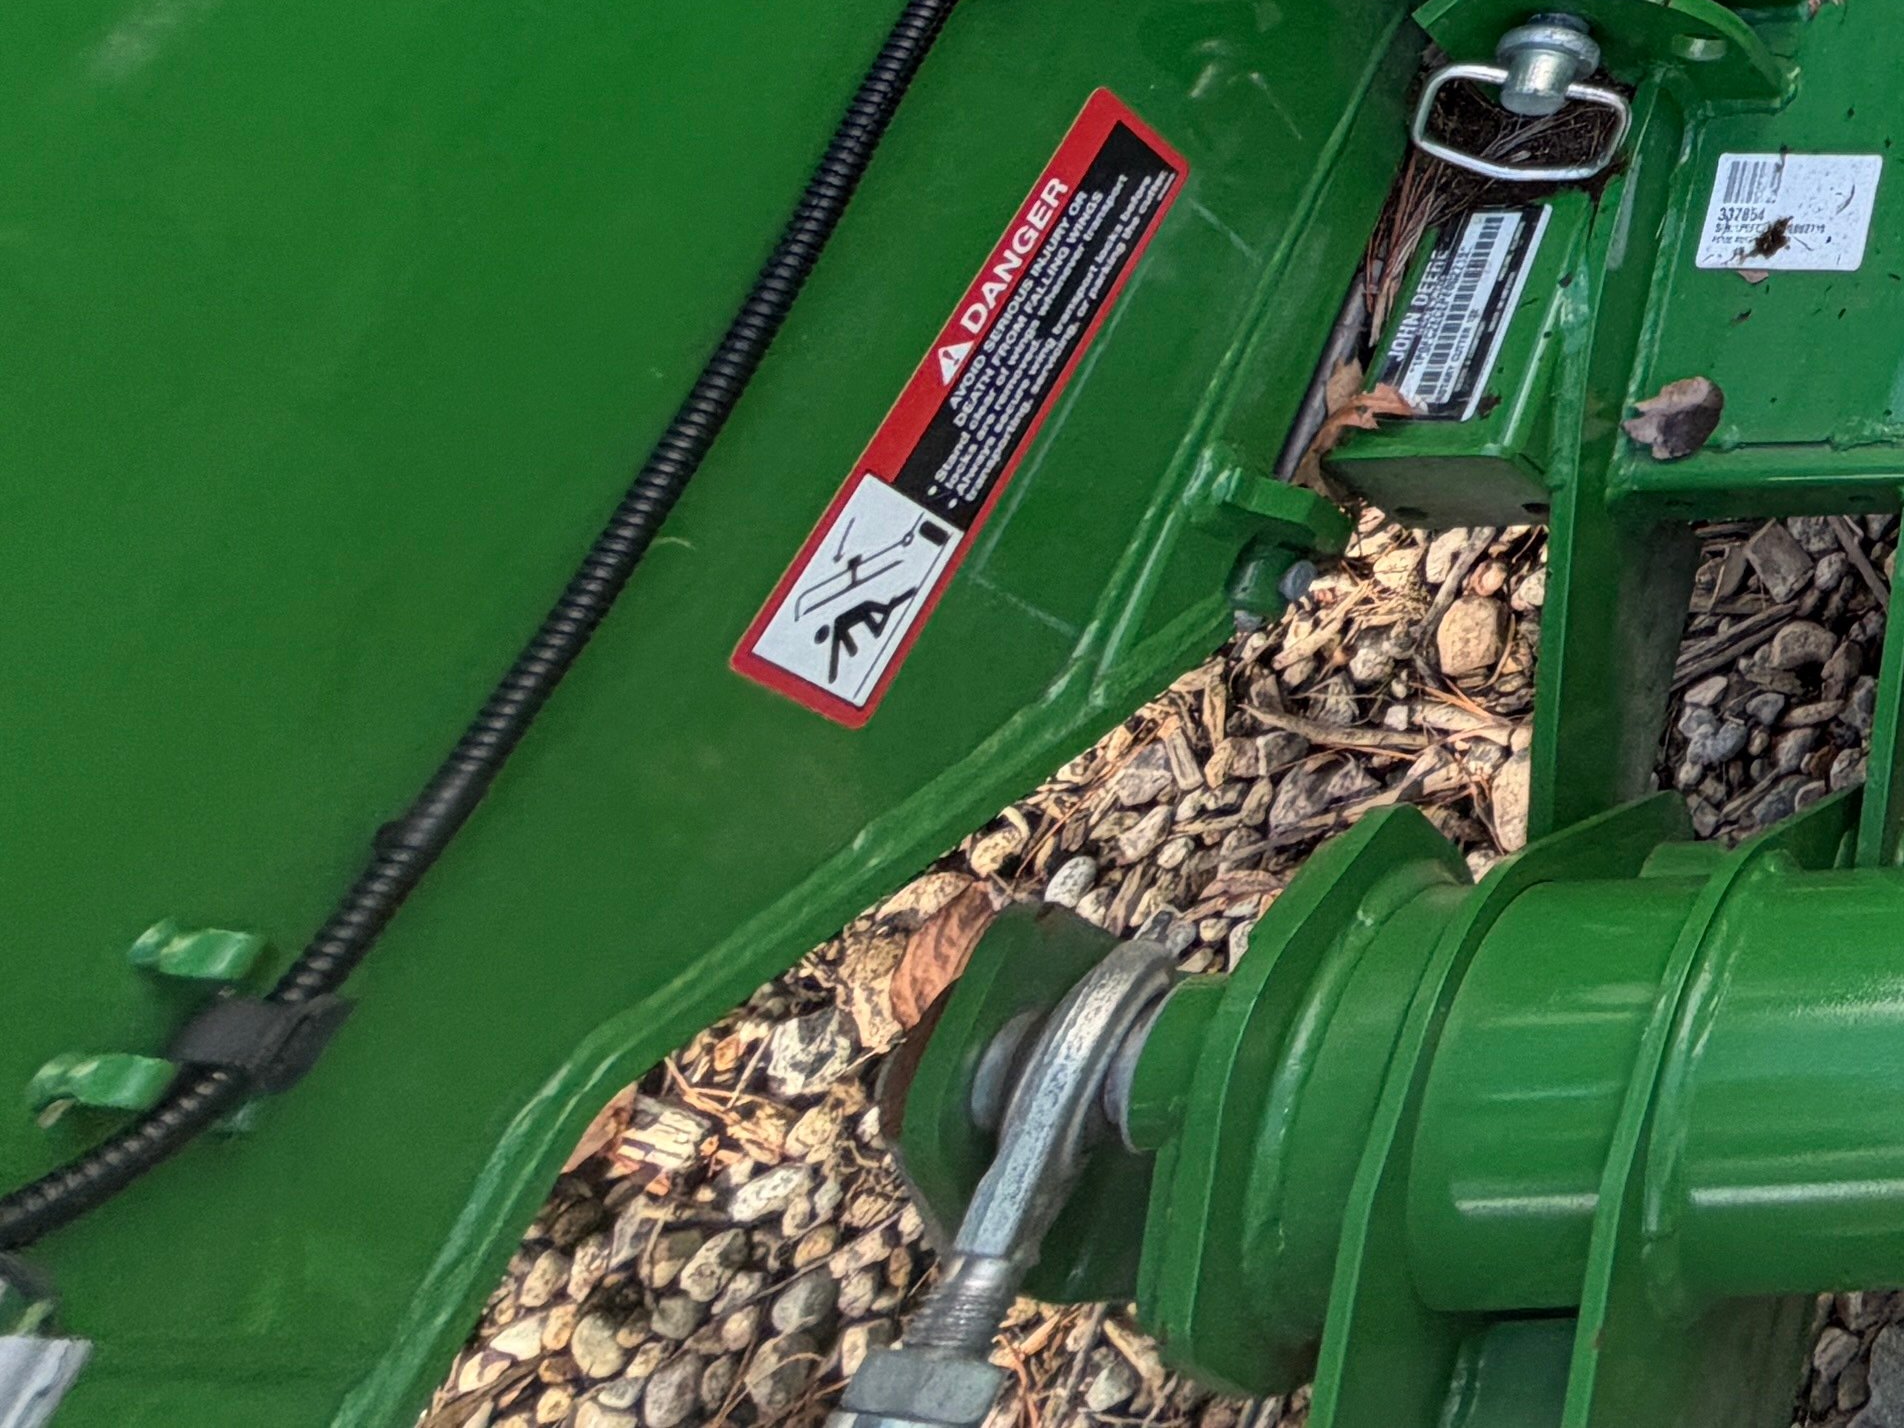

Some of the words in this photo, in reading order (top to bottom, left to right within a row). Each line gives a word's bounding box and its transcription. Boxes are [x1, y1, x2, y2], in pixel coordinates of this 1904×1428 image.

[933, 430, 971, 484] Stand
[965, 386, 998, 432] clear
[992, 365, 1010, 387] of
[1004, 316, 1042, 368] wings
[1035, 241, 1085, 317] whenever
[1081, 172, 1129, 243] transport
[947, 352, 988, 410] AVOID
[982, 276, 1034, 354] SERIOUS
[1029, 215, 1071, 277] INJURY
[1066, 189, 1088, 217] OR
[952, 366, 996, 428] DEATH
[989, 313, 1028, 367] FROM
[1022, 243, 1071, 314] FALLING
[1064, 188, 1104, 246] WINGS
[953, 433, 999, 497] Always
[991, 376, 1031, 434] secure
[1026, 335, 1058, 378] wing
[1051, 263, 1100, 337] transport
[1094, 222, 1123, 264] locks
[1119, 173, 1152, 222] before
[958, 174, 1069, 335] DANGER
[1388, 310, 1422, 362] JOHN
[1410, 248, 1449, 307] DEERE
[944, 440, 979, 490] locks
[973, 411, 997, 442] are
[992, 336, 1042, 411] removed.
